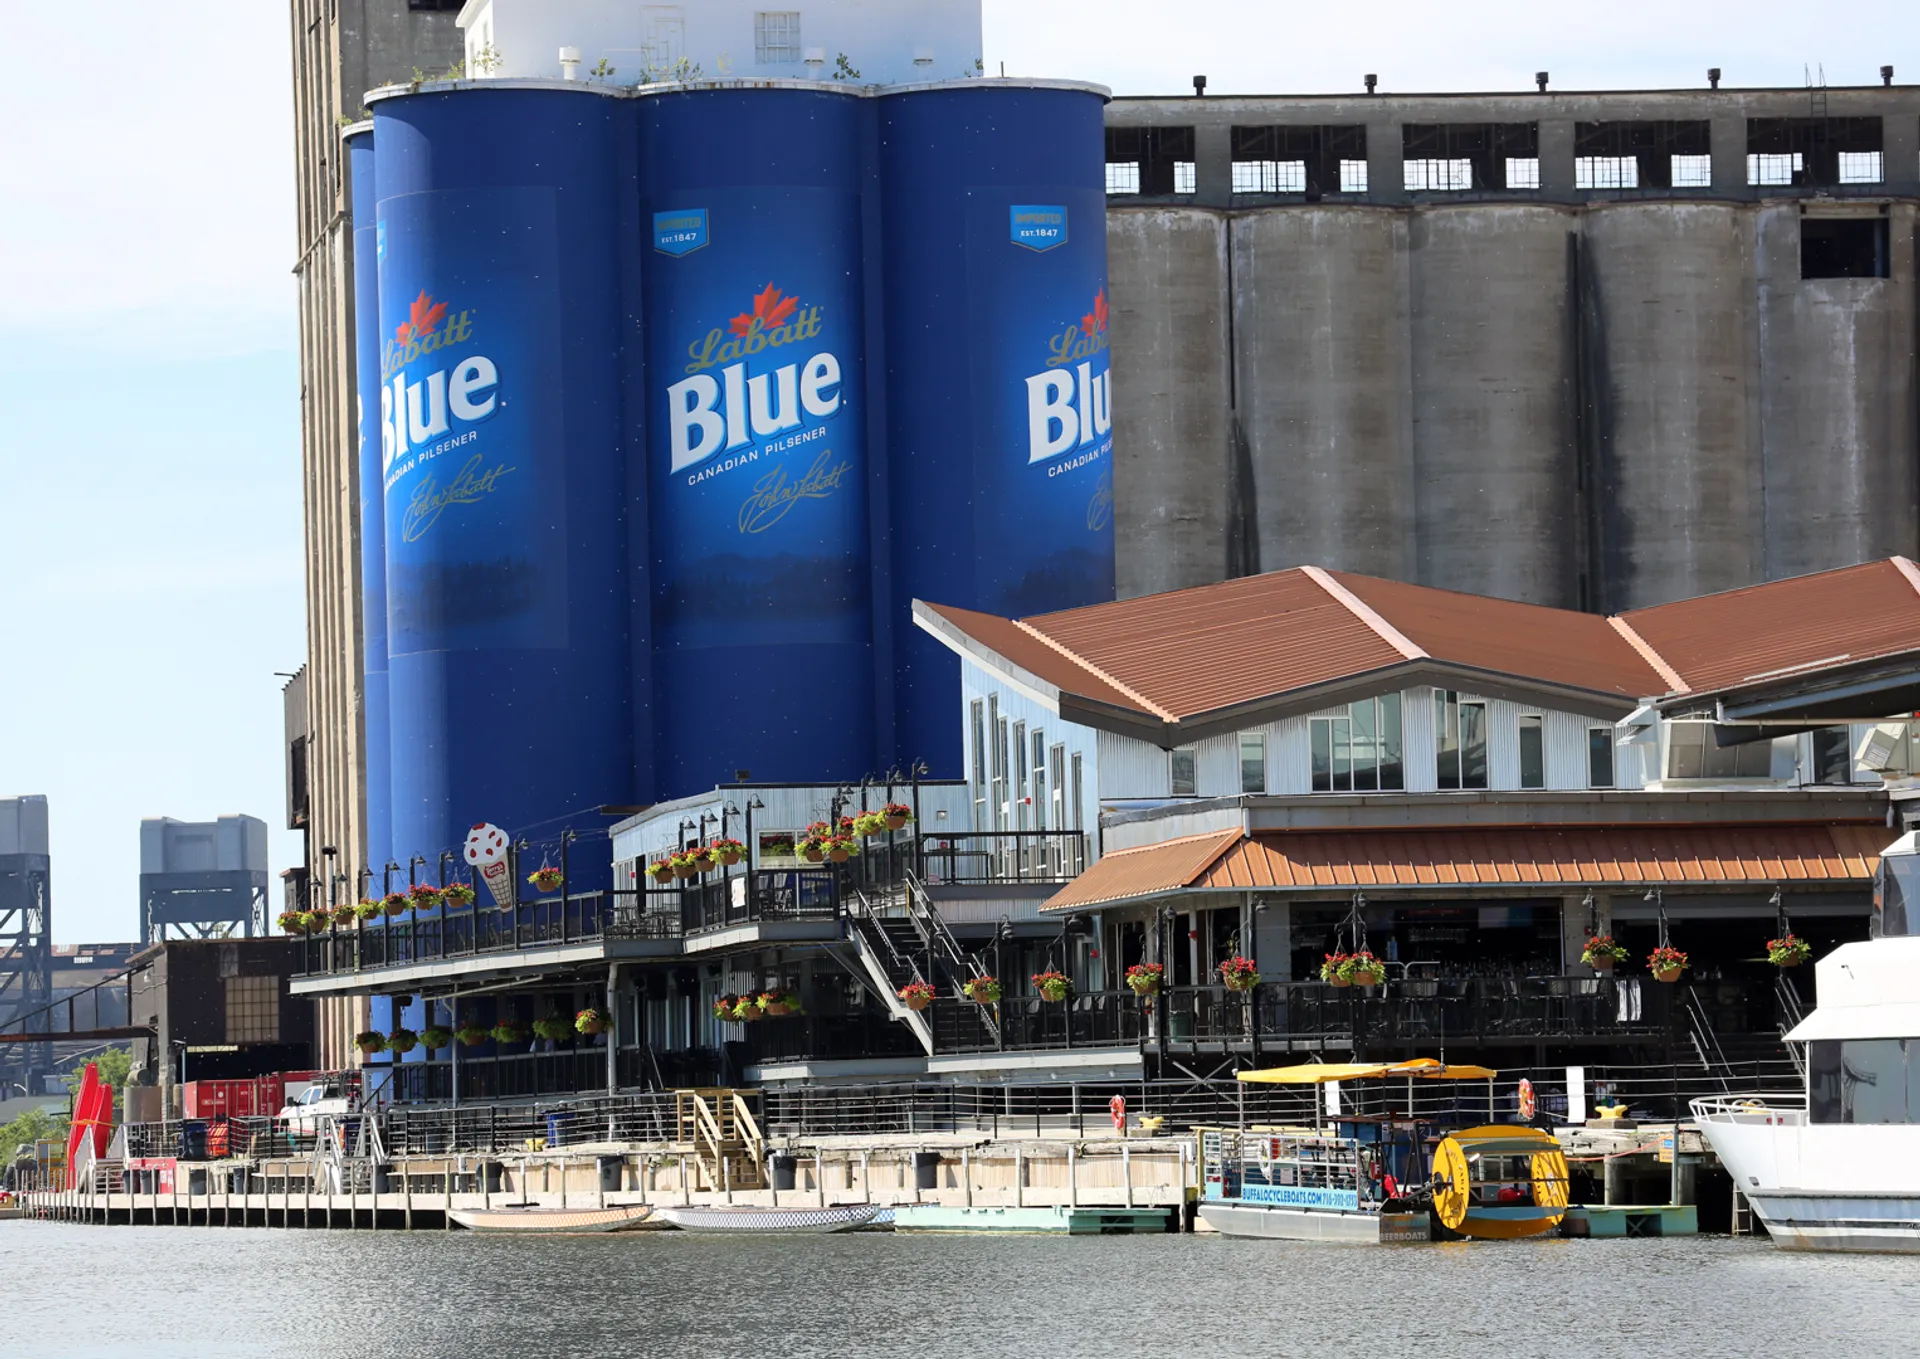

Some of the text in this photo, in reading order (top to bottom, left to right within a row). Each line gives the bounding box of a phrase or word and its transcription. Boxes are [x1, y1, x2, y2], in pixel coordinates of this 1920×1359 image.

[685, 306, 821, 375] Labatt
[667, 352, 842, 476] Blue
[384, 431, 477, 494] ANADIAN PILSENER
[688, 426, 826, 486] CANADIAN PILSENER
[1048, 448, 1099, 478] CANADIAN
[1242, 1187, 1322, 1205] BUFFALOCYCLEBOATS.COM
